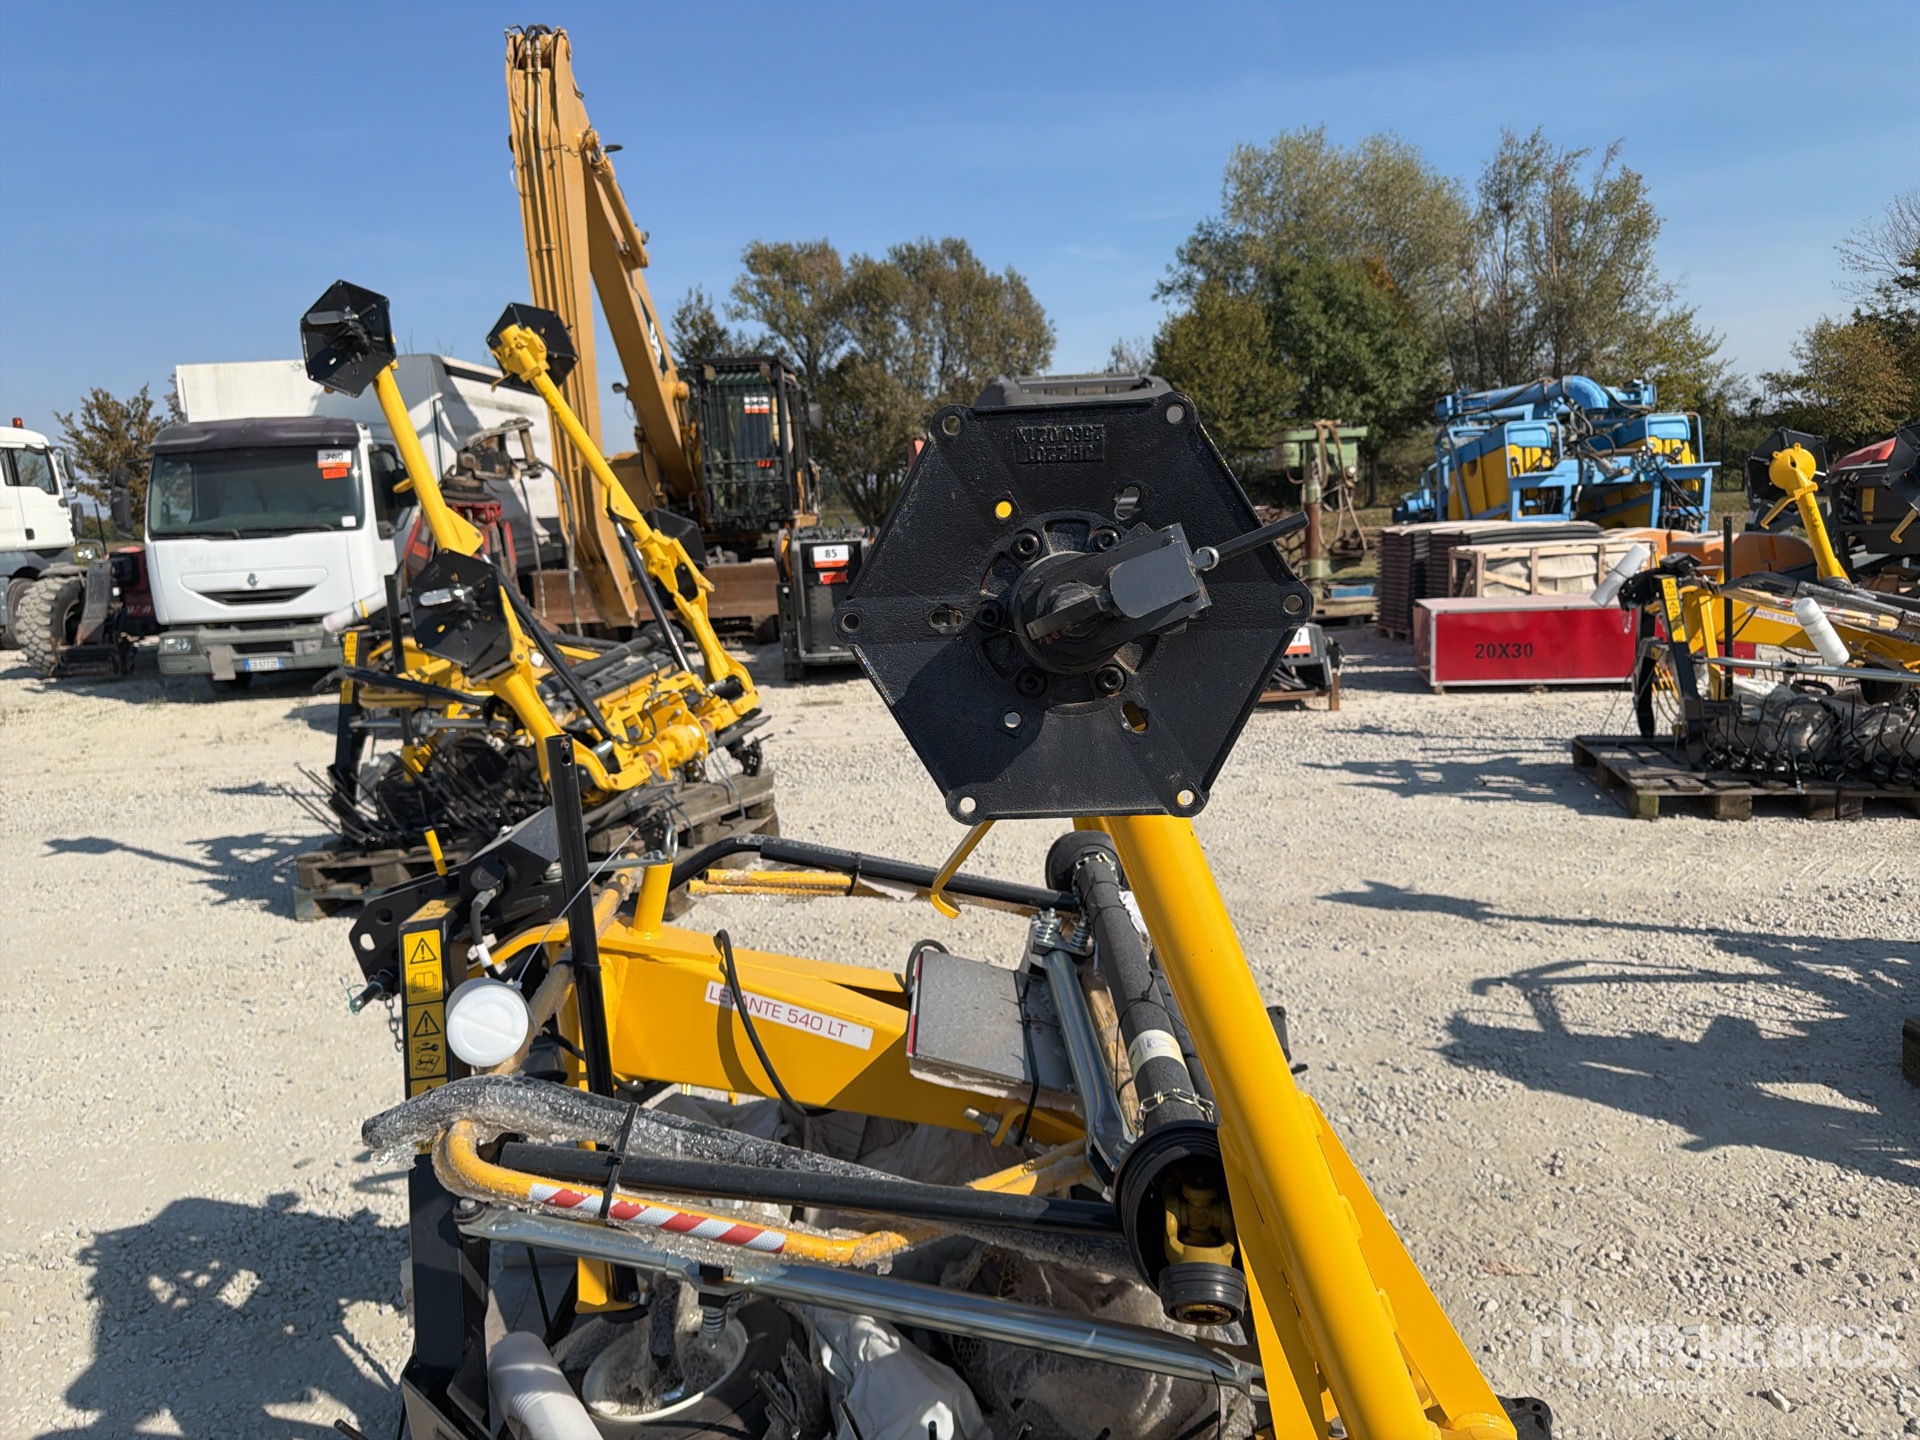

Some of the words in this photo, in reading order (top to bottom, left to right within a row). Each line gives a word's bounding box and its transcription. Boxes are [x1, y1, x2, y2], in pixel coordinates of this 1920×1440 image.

[825, 549, 838, 558] 85
[1475, 643, 1533, 659] 20X30
[787, 1009, 823, 1031] 540
[828, 1020, 848, 1038] LT
